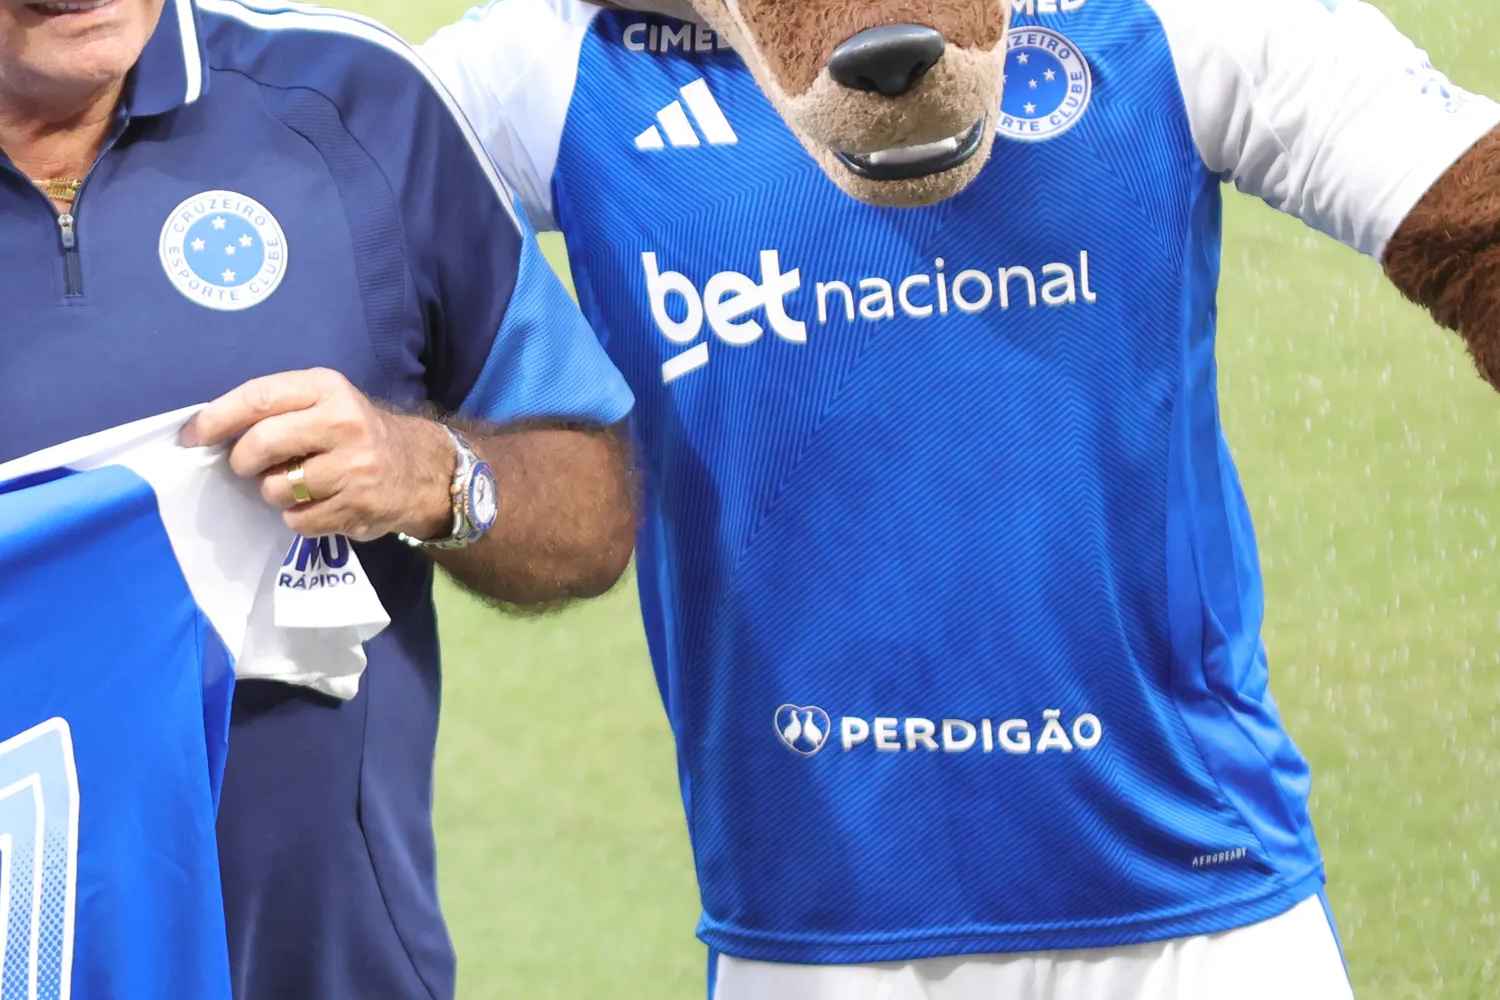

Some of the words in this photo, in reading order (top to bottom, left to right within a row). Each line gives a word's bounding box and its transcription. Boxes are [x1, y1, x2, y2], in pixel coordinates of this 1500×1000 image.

[1007, 33, 1071, 60] ZEIRO
[1049, 70, 1083, 126] CLUBE
[173, 198, 266, 233] CRUZEIRO
[168, 246, 241, 301] ESPORTE
[248, 237, 280, 294] CLUBE
[279, 571, 357, 590] RÁPIDO
[840, 708, 1102, 754] PERDIGÃO
